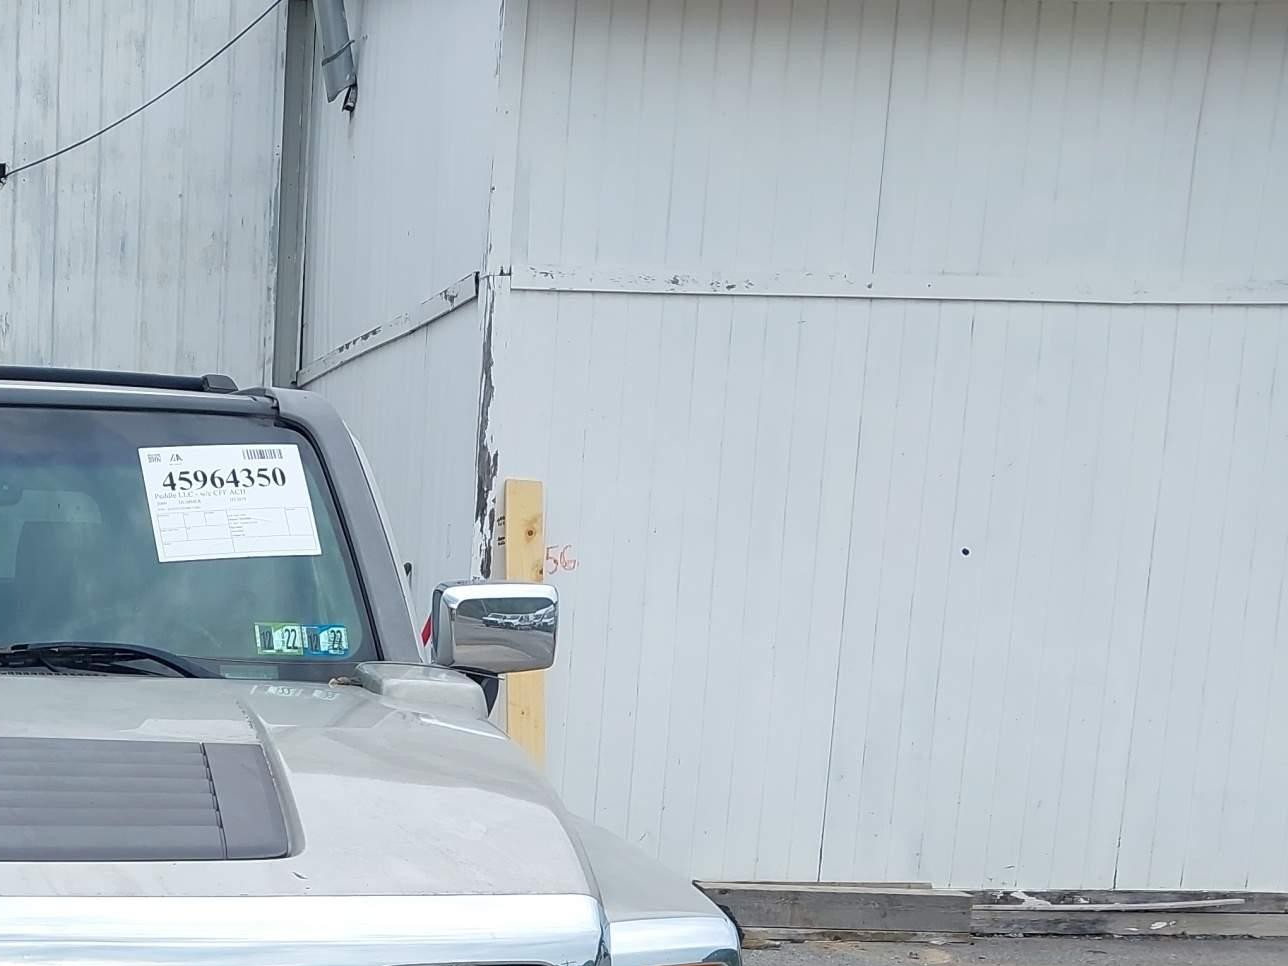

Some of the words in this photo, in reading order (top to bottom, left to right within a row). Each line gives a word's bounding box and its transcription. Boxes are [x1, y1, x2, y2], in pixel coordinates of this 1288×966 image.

[162, 467, 286, 491] 45964350
[285, 628, 299, 650] 22
[330, 629, 343, 651] 22
